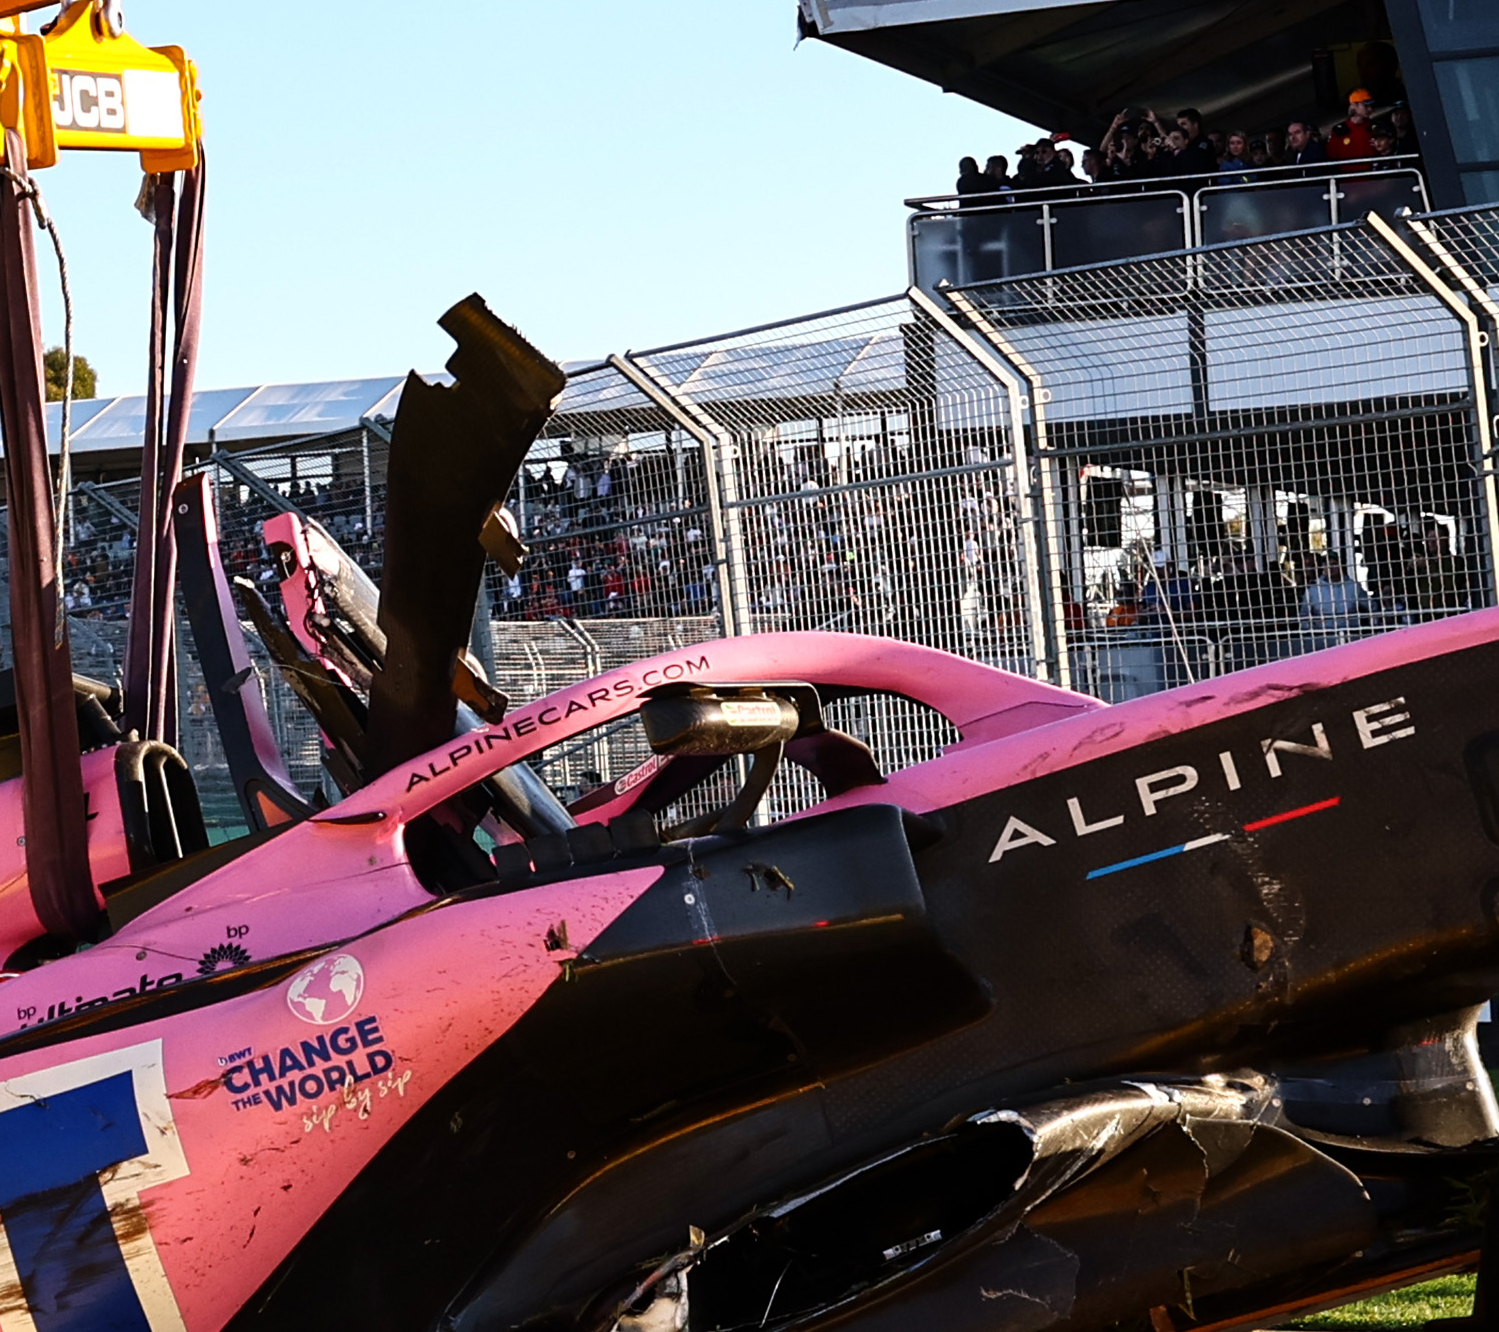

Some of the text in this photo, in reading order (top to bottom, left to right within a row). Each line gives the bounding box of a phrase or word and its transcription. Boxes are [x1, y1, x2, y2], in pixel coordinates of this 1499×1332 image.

[52, 74, 125, 129] JCB
[405, 655, 710, 793] ALPINECARS.COM
[988, 696, 1416, 864] ALPINE
[226, 924, 250, 939] bp
[17, 1006, 37, 1020] bp
[224, 1016, 385, 1095] CHANGE
[228, 1047, 253, 1064] BWT
[232, 1050, 393, 1113] THE WORLD
[303, 1070, 412, 1133] sip by sip
